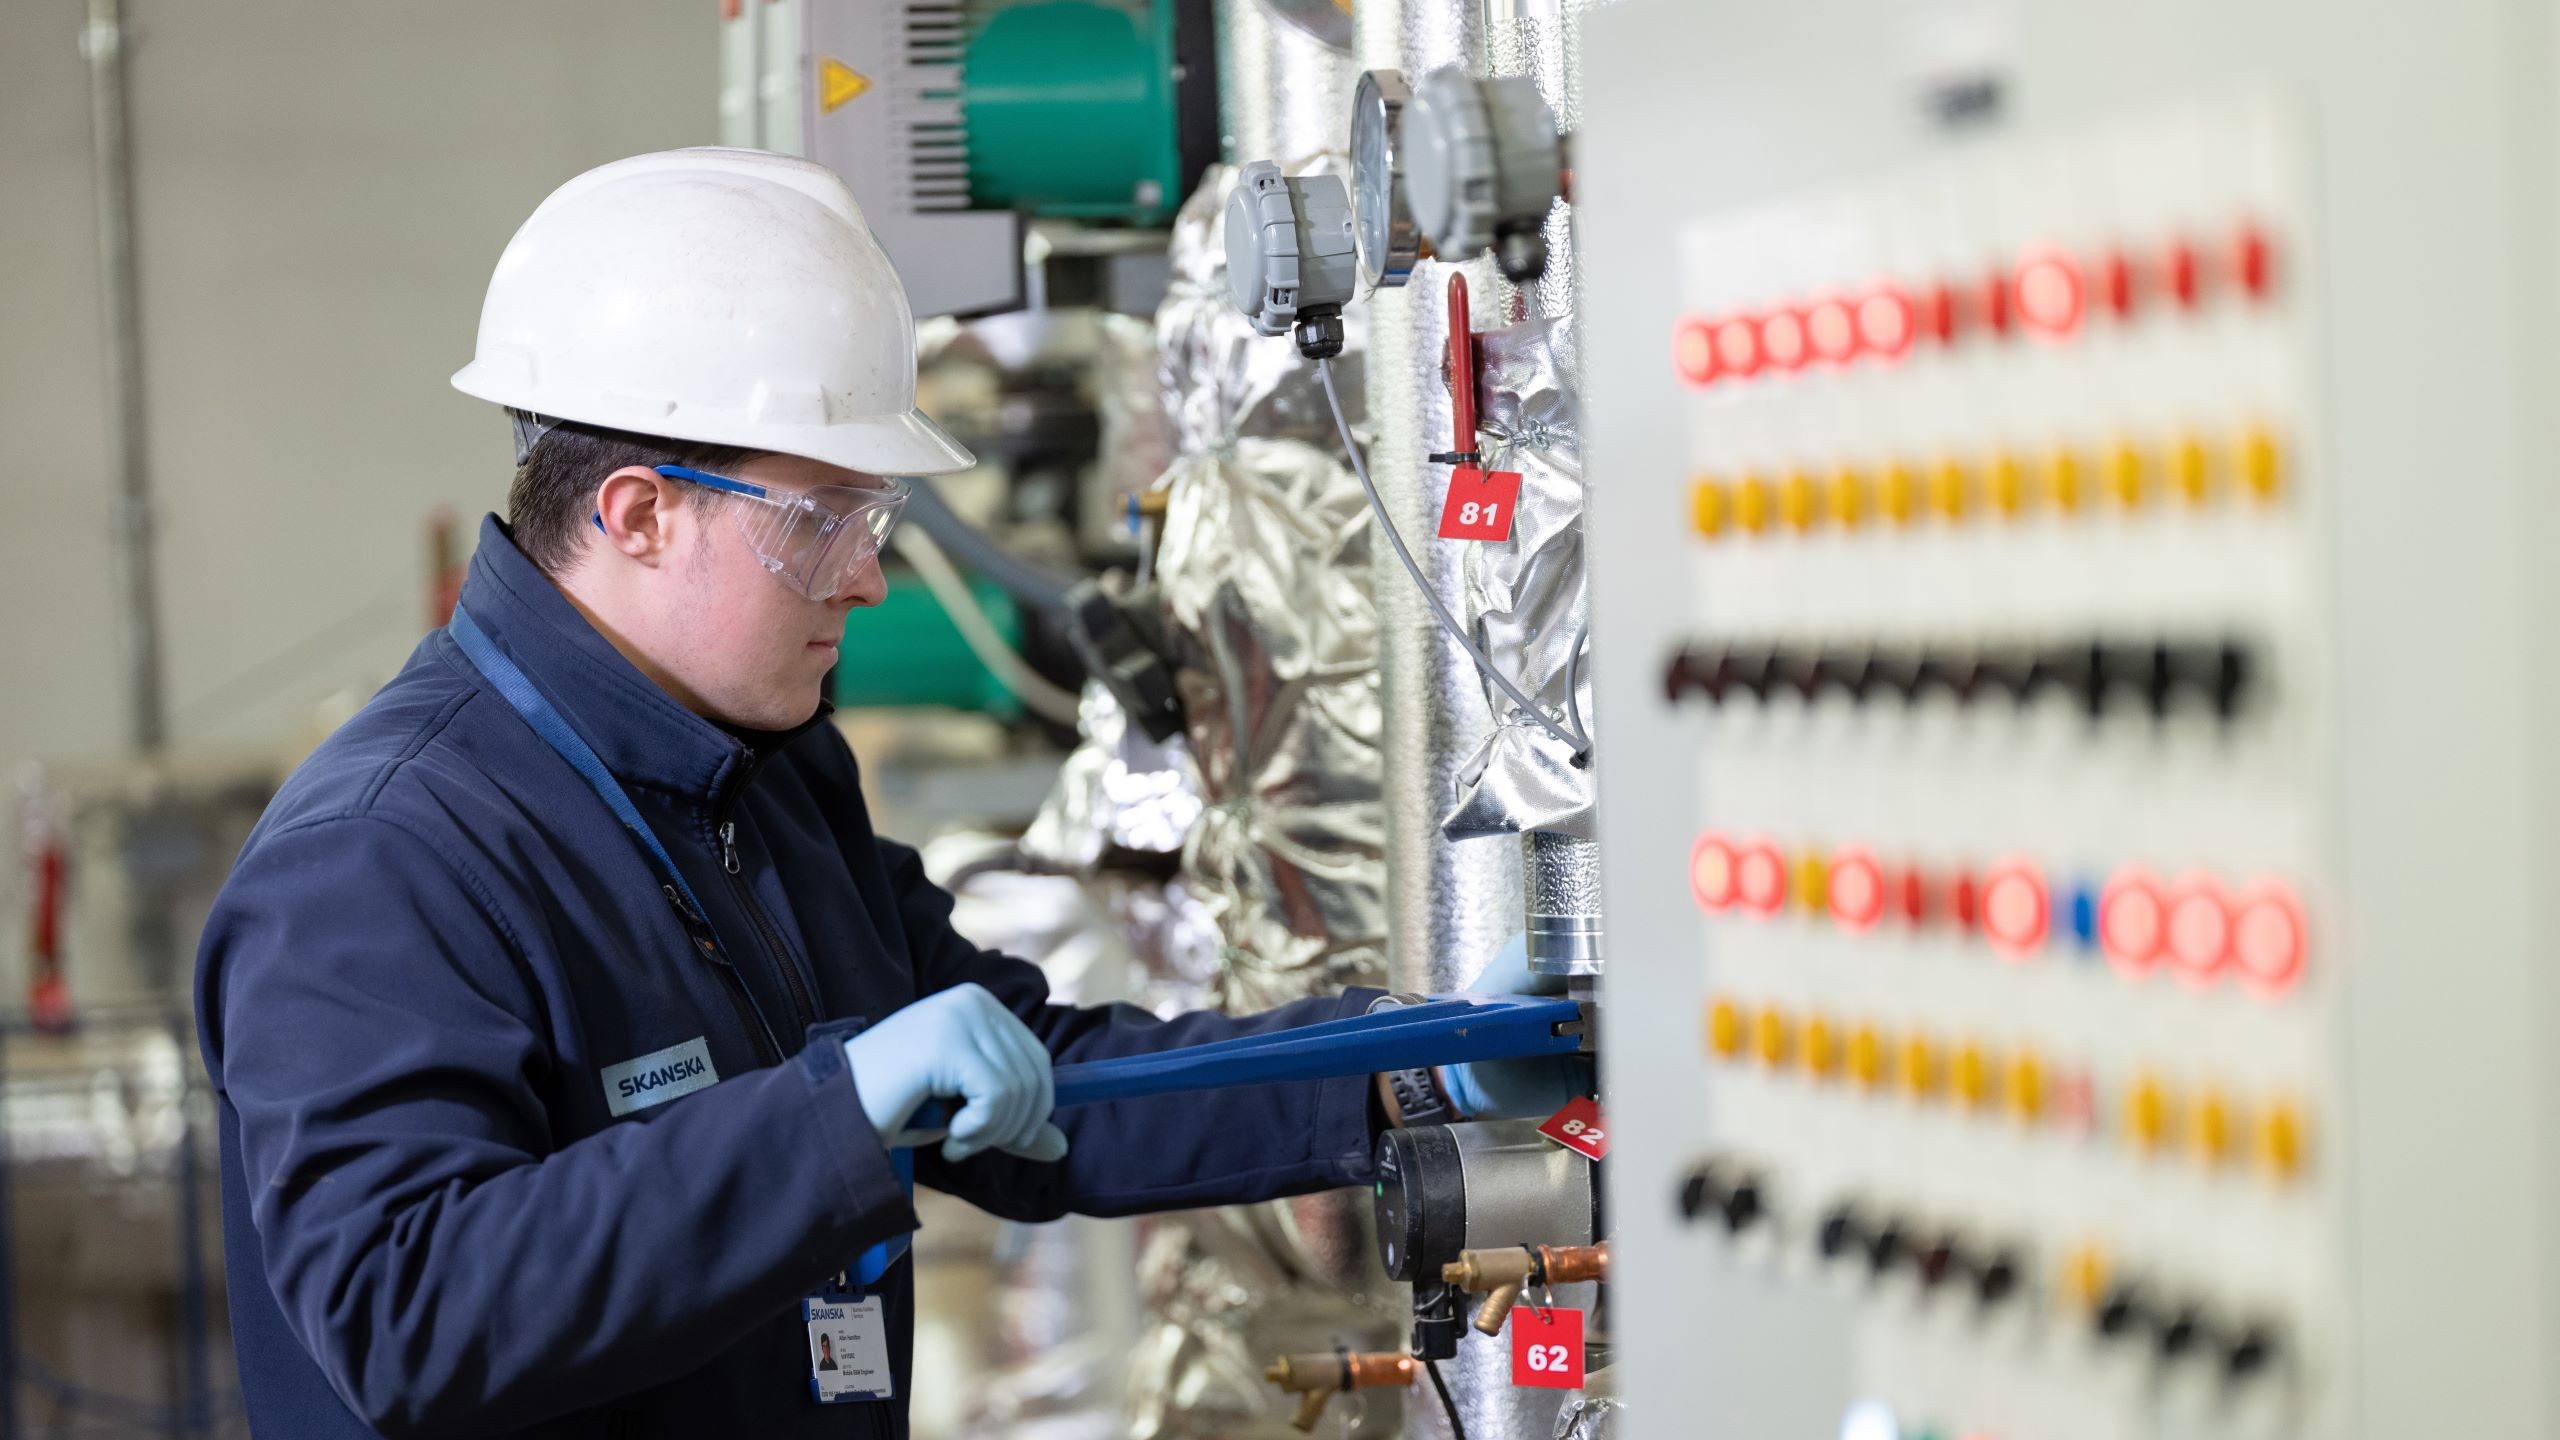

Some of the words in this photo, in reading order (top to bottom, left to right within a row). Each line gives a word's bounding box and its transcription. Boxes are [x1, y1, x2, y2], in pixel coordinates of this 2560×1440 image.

[1459, 502, 1498, 526] 81
[618, 1056, 706, 1098] SKANSKA
[1562, 1119, 1605, 1146] 82
[811, 1308, 845, 1320] SKANSKA
[1527, 1344, 1569, 1372] 62
